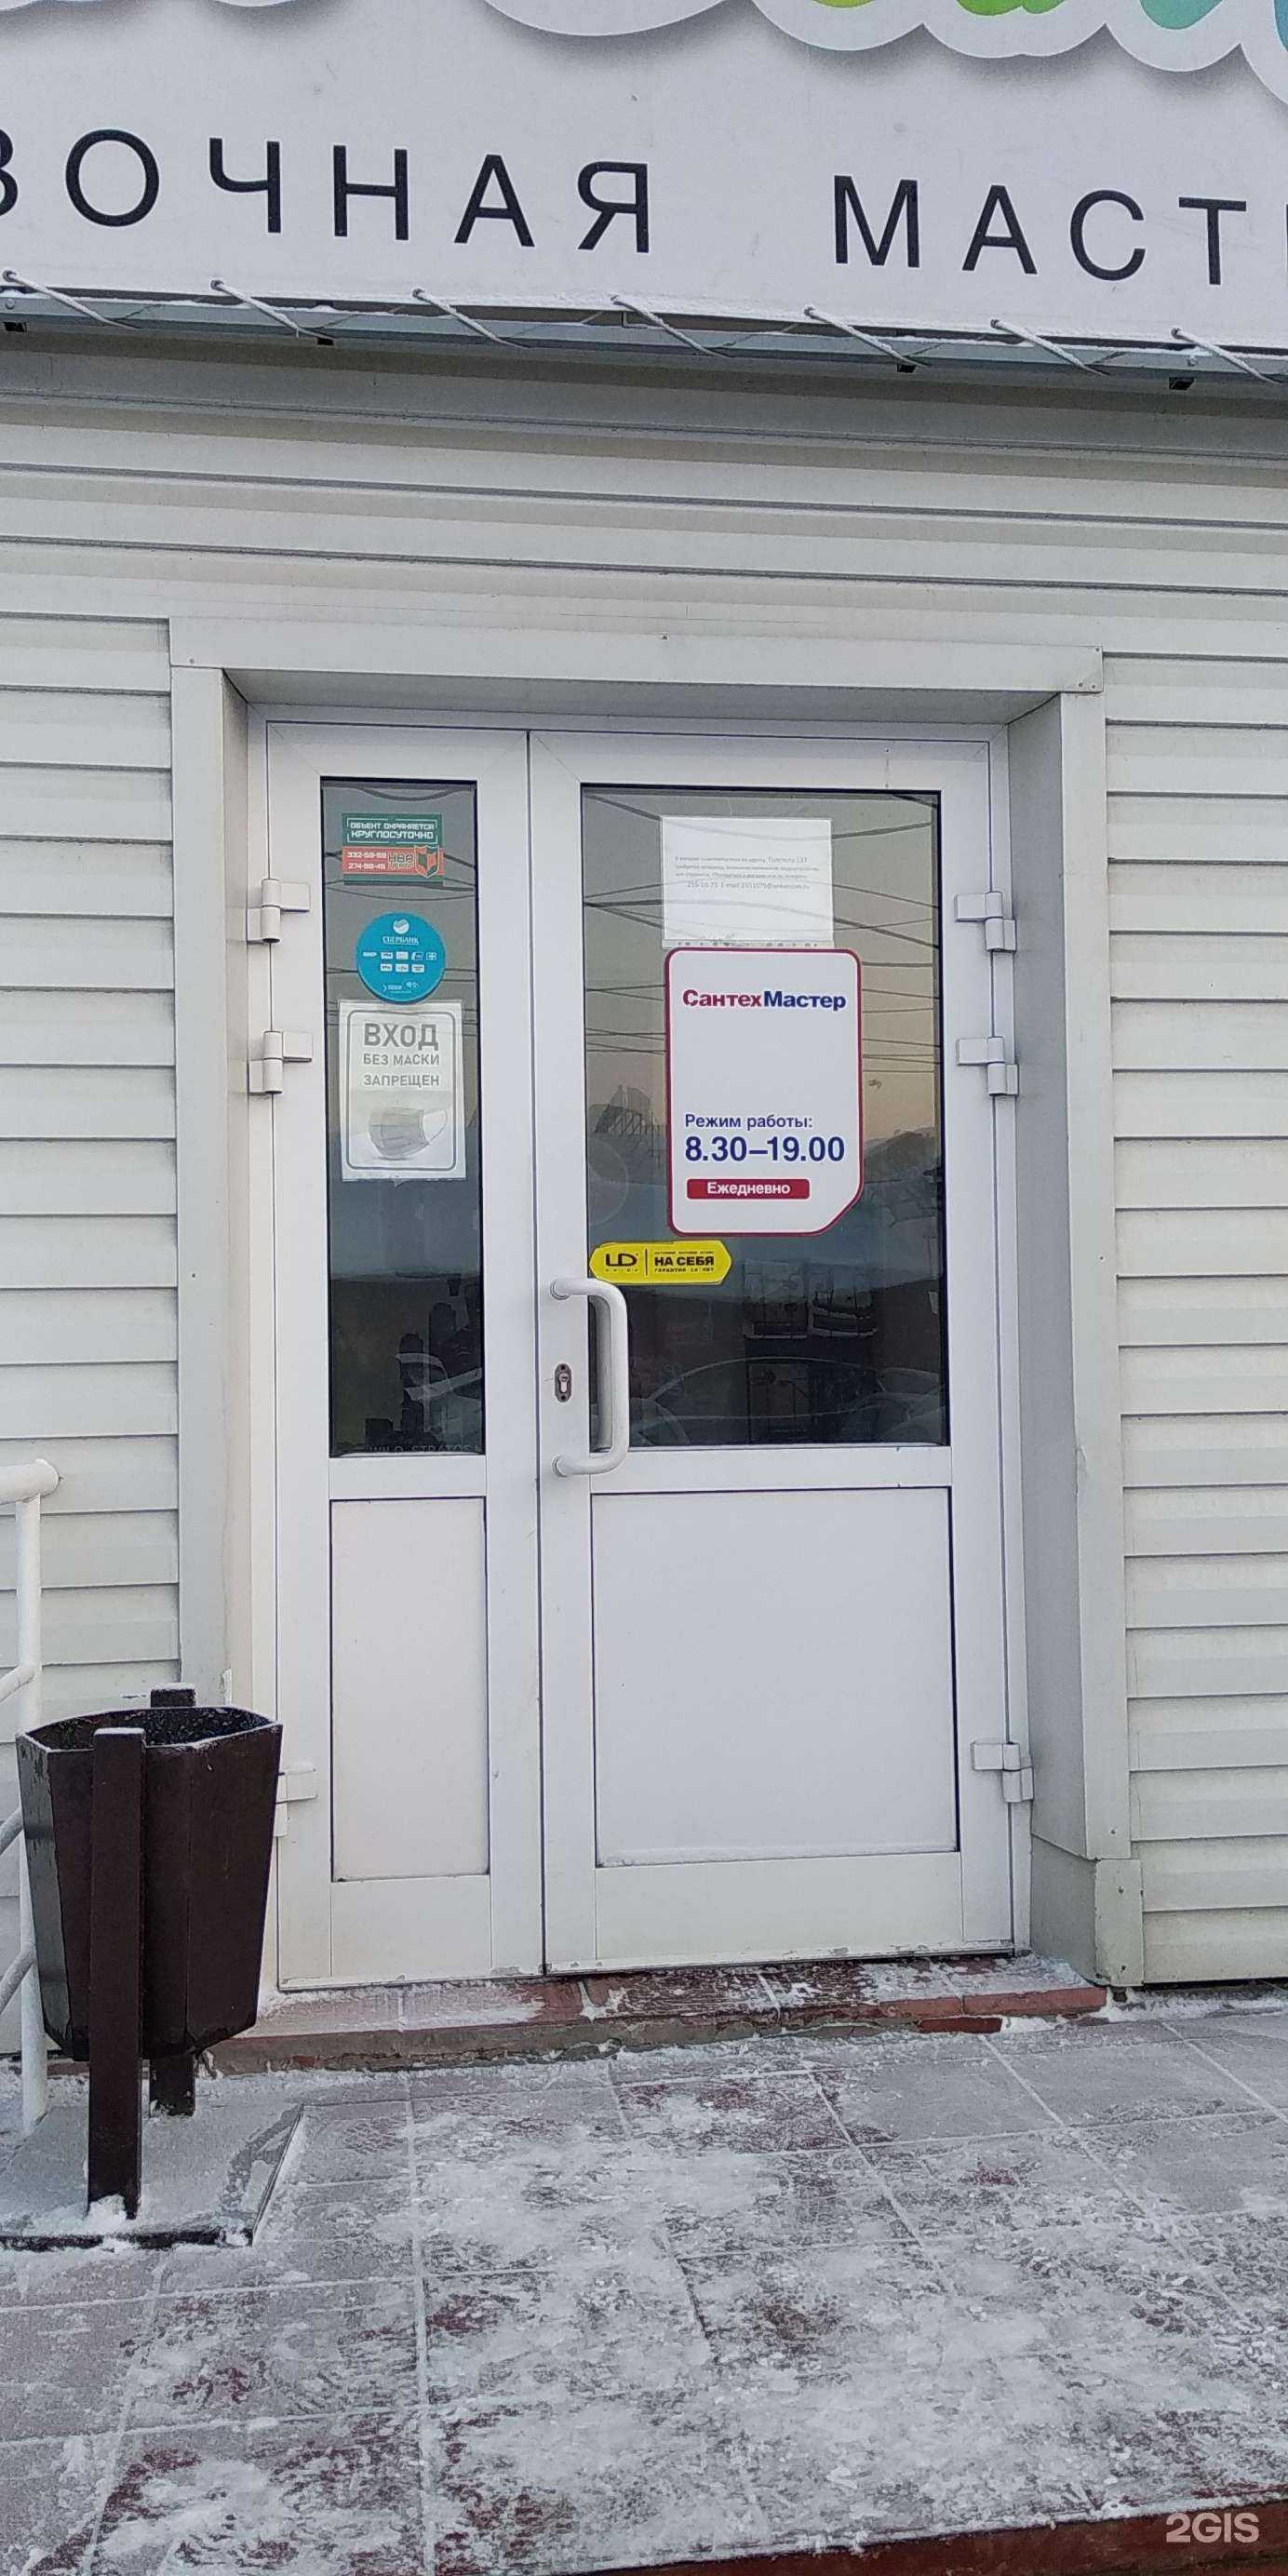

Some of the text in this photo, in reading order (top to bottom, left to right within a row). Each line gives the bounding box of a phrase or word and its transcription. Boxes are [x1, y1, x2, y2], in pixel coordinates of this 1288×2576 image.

[0, 128, 1288, 286] ОЧНАЯ МАСТ
[351, 830, 434, 839] КРУГЛОСУТОЧНО
[682, 988, 846, 1012] СантехМастер
[364, 1023, 438, 1051] ВХОД
[363, 1053, 439, 1066] БЕЗ МАСКИ
[364, 1074, 439, 1088] ЗАПРЕЩЕН
[685, 1114, 812, 1131] Режим работы:
[706, 1181, 791, 1196] Ежедневно
[654, 1256, 714, 1267] НА СЕБЯ
